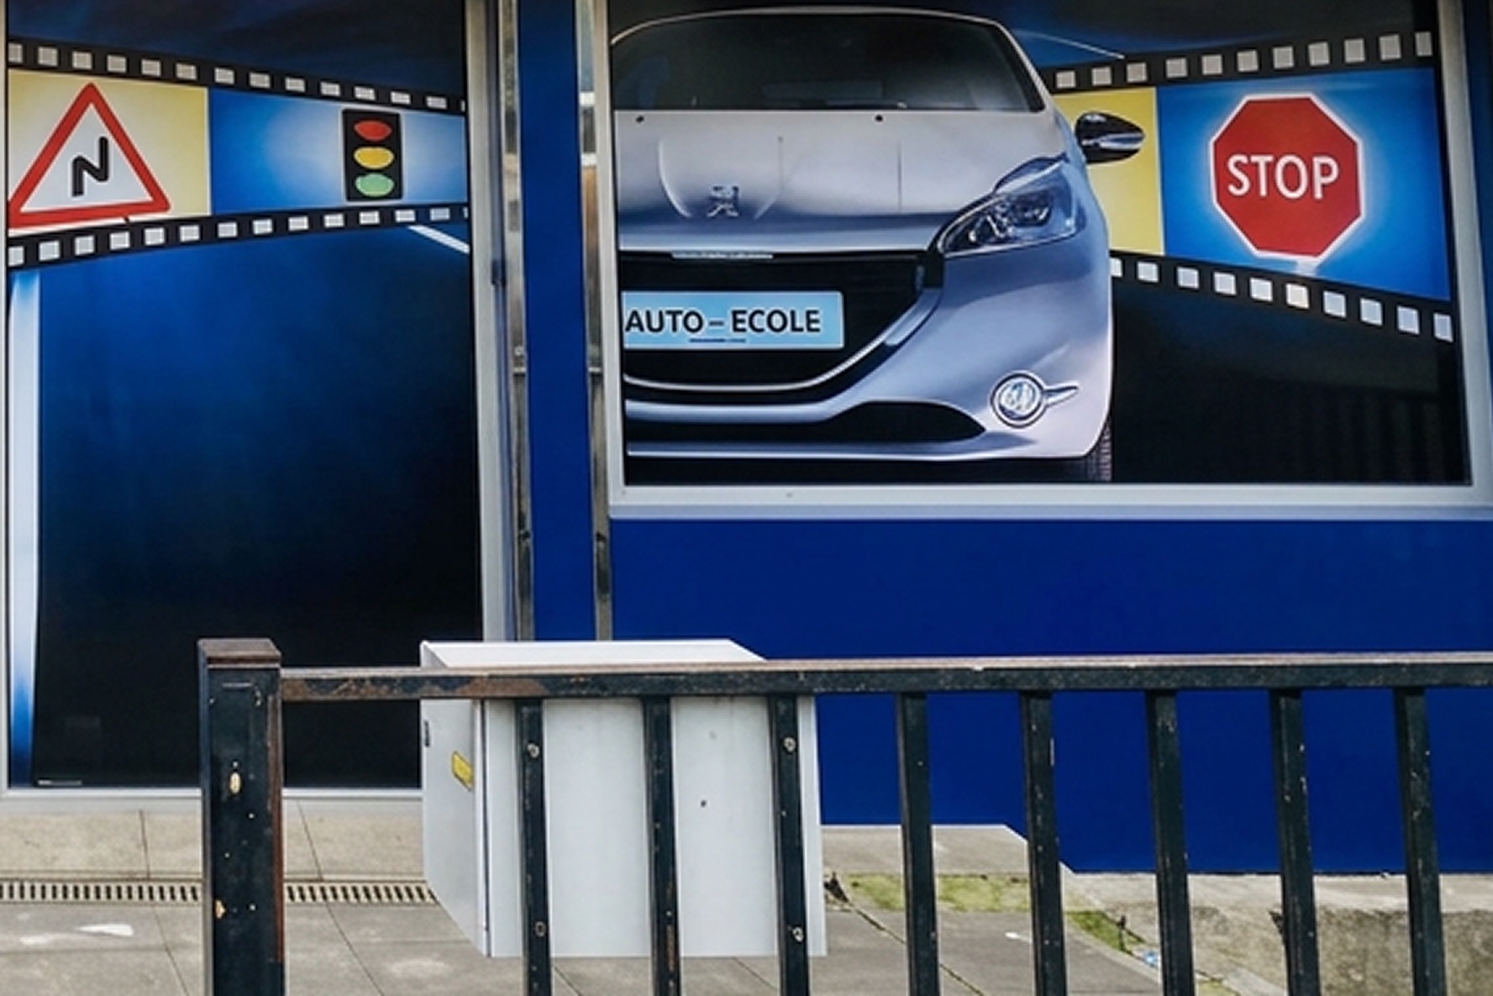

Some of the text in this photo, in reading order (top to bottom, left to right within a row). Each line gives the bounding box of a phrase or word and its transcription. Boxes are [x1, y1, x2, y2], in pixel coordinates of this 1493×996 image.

[1227, 154, 1339, 200] STOP
[625, 309, 704, 333] AUTO
[731, 309, 821, 333] ECOLE
